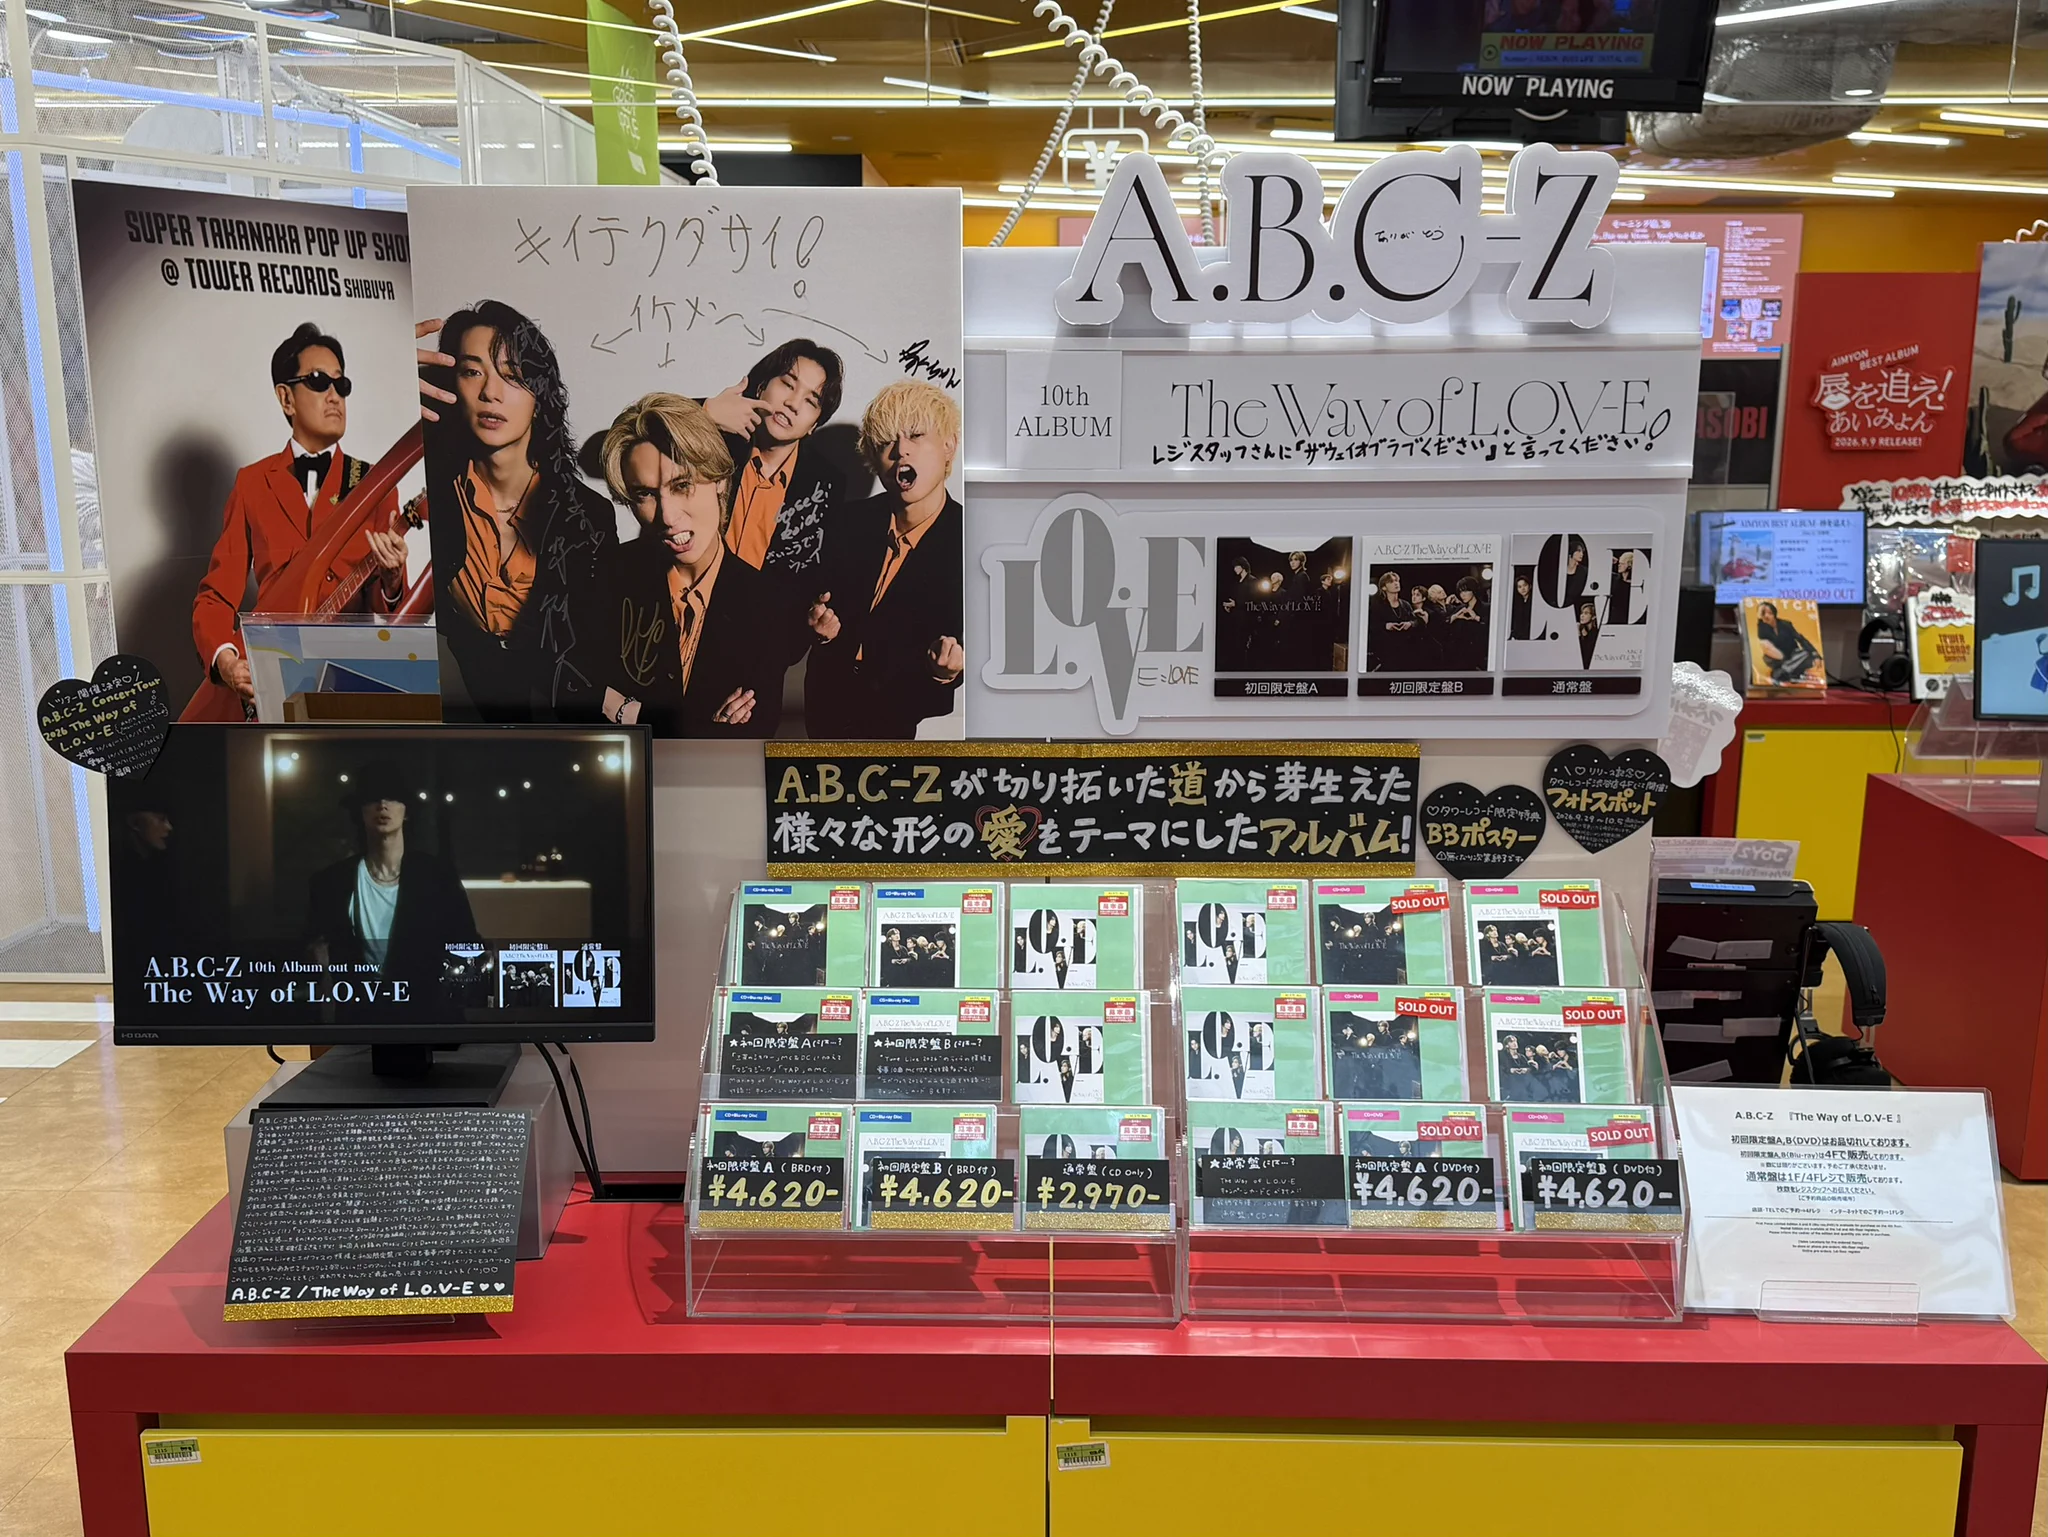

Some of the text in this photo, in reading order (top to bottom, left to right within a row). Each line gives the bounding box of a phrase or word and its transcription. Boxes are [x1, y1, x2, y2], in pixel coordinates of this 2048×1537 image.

[1499, 35, 1646, 51] NOW PLAYING
[1462, 76, 1615, 99] NOW PLAYING
[124, 209, 195, 247] SUPER
[197, 216, 302, 255] TAKANAKA
[304, 226, 340, 258] POP
[345, 230, 368, 260] UP
[1075, 165, 1600, 306] A.B.C-Z
[1375, 225, 1445, 243] ありがとう
[160, 257, 395, 301] @ TOWER RECORDS SHIBUYA
[1830, 344, 1920, 371] AIMYON BEST ALBUM
[1039, 384, 1090, 407] 10th
[1815, 369, 1955, 412] 唇を追え!
[1171, 377, 1651, 447] The Way of L.O.V-E
[1014, 415, 1113, 438] ALBUM
[1828, 410, 1935, 435] あいみょん
[1833, 588, 1856, 600] OUT
[1244, 681, 1319, 695] 初回限定盤A
[1389, 680, 1464, 694] 初回限定盤B
[1551, 680, 1593, 693] 通常盤
[42, 701, 88, 728] A.B.C-Z
[91, 688, 137, 709] Concert
[133, 677, 161, 693] Tour
[43, 725, 69, 742] 2026
[69, 720, 92, 733] The
[92, 709, 119, 725] Way
[122, 700, 138, 714] of
[59, 724, 115, 753] L.O.V-E
[773, 762, 1413, 806] A.B.C-Z が切り拓いた道から芽生えた
[1545, 787, 1658, 816] フォトスポット
[1391, 896, 1447, 912] SOLD OUT
[1541, 893, 1596, 906] SOLD OUT
[144, 956, 380, 979] A.B.C-Z 10th Album out now
[144, 980, 411, 1010] The Way of L.O.V-E
[1397, 1001, 1455, 1016] SOLD OUT
[1565, 1007, 1623, 1022] SOLD OUT
[1734, 1111, 1774, 1121] A.B.C-Z
[1816, 1113, 1838, 1123] Way
[1841, 1112, 1852, 1122] of
[1854, 1113, 1894, 1123] L.O.V-E
[1419, 1124, 1480, 1139] SOLD OUT
[1590, 1126, 1650, 1144] SOLD OUT
[706, 1160, 775, 1175] 初回限定盤A
[877, 1160, 942, 1175] 初回限定盤B
[1062, 1161, 1098, 1176] 通常盤
[1354, 1160, 1426, 1175] 初回限定盤A
[1537, 1160, 1608, 1176] 初回限定盤B
[231, 1281, 475, 1301] A.B.C-Z / The Way of L.O.V-E
